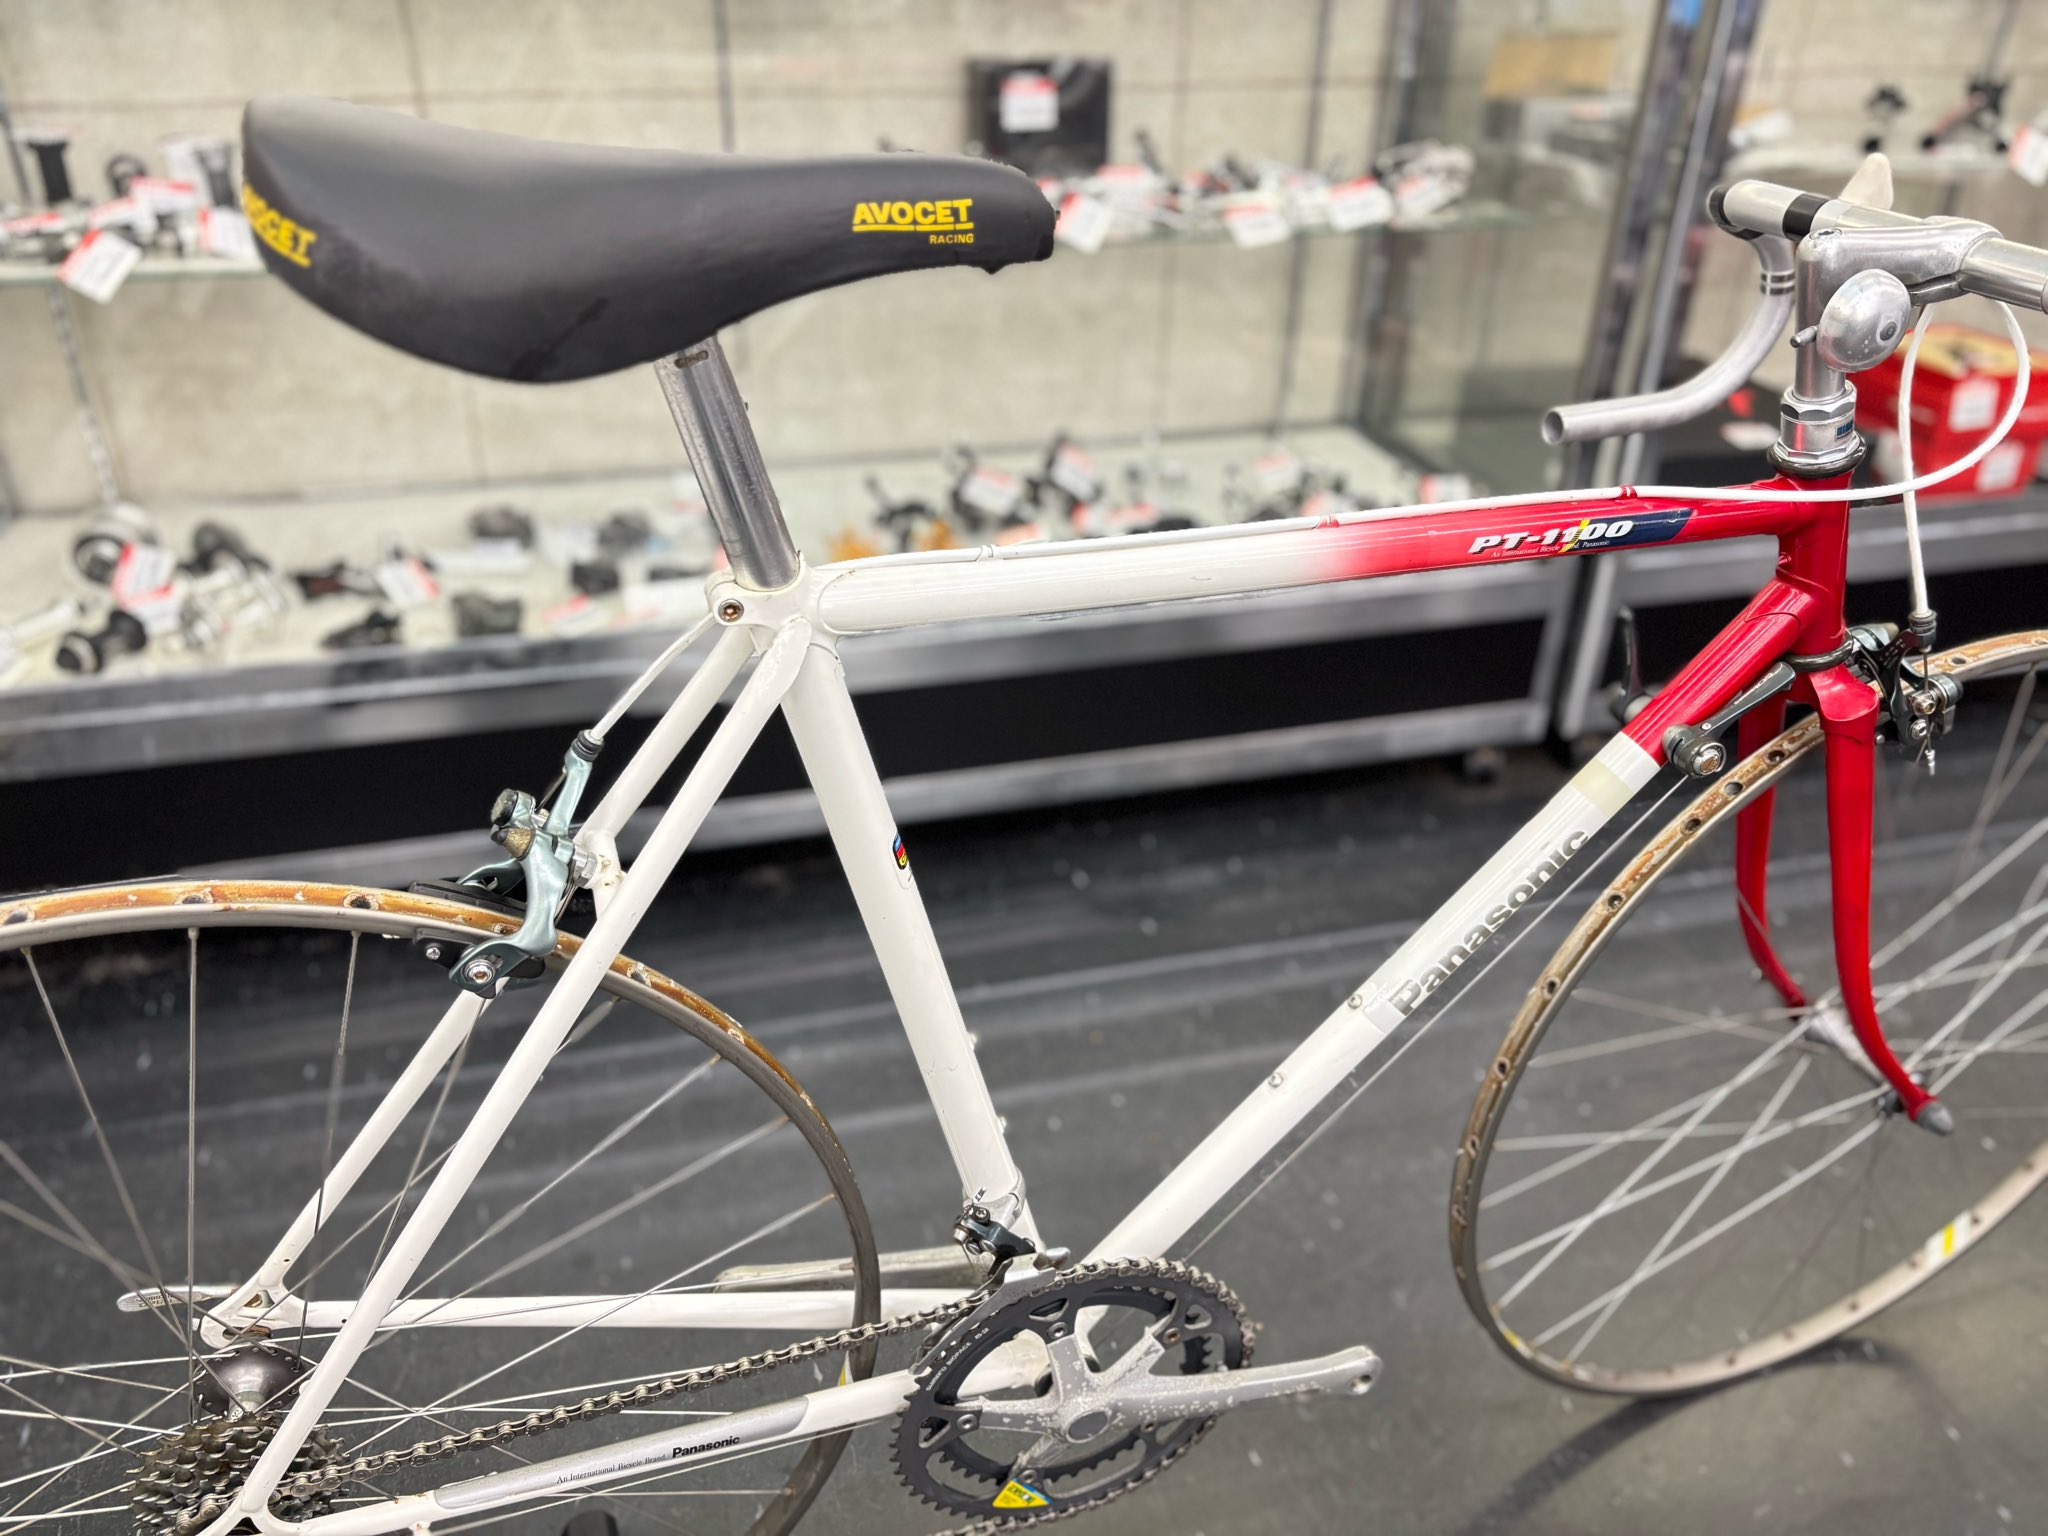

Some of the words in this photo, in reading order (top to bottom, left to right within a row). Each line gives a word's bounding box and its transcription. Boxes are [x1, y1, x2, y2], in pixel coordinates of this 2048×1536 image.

[852, 198, 973, 225] AVOCET
[929, 233, 974, 245] RACING
[1467, 519, 1634, 553] PT-1100
[1388, 830, 1589, 1017] Panasonic
[556, 1475, 568, 1485] An
[570, 1464, 615, 1481] International
[618, 1459, 643, 1471] Bicycle
[672, 1435, 741, 1458] Panasonic
